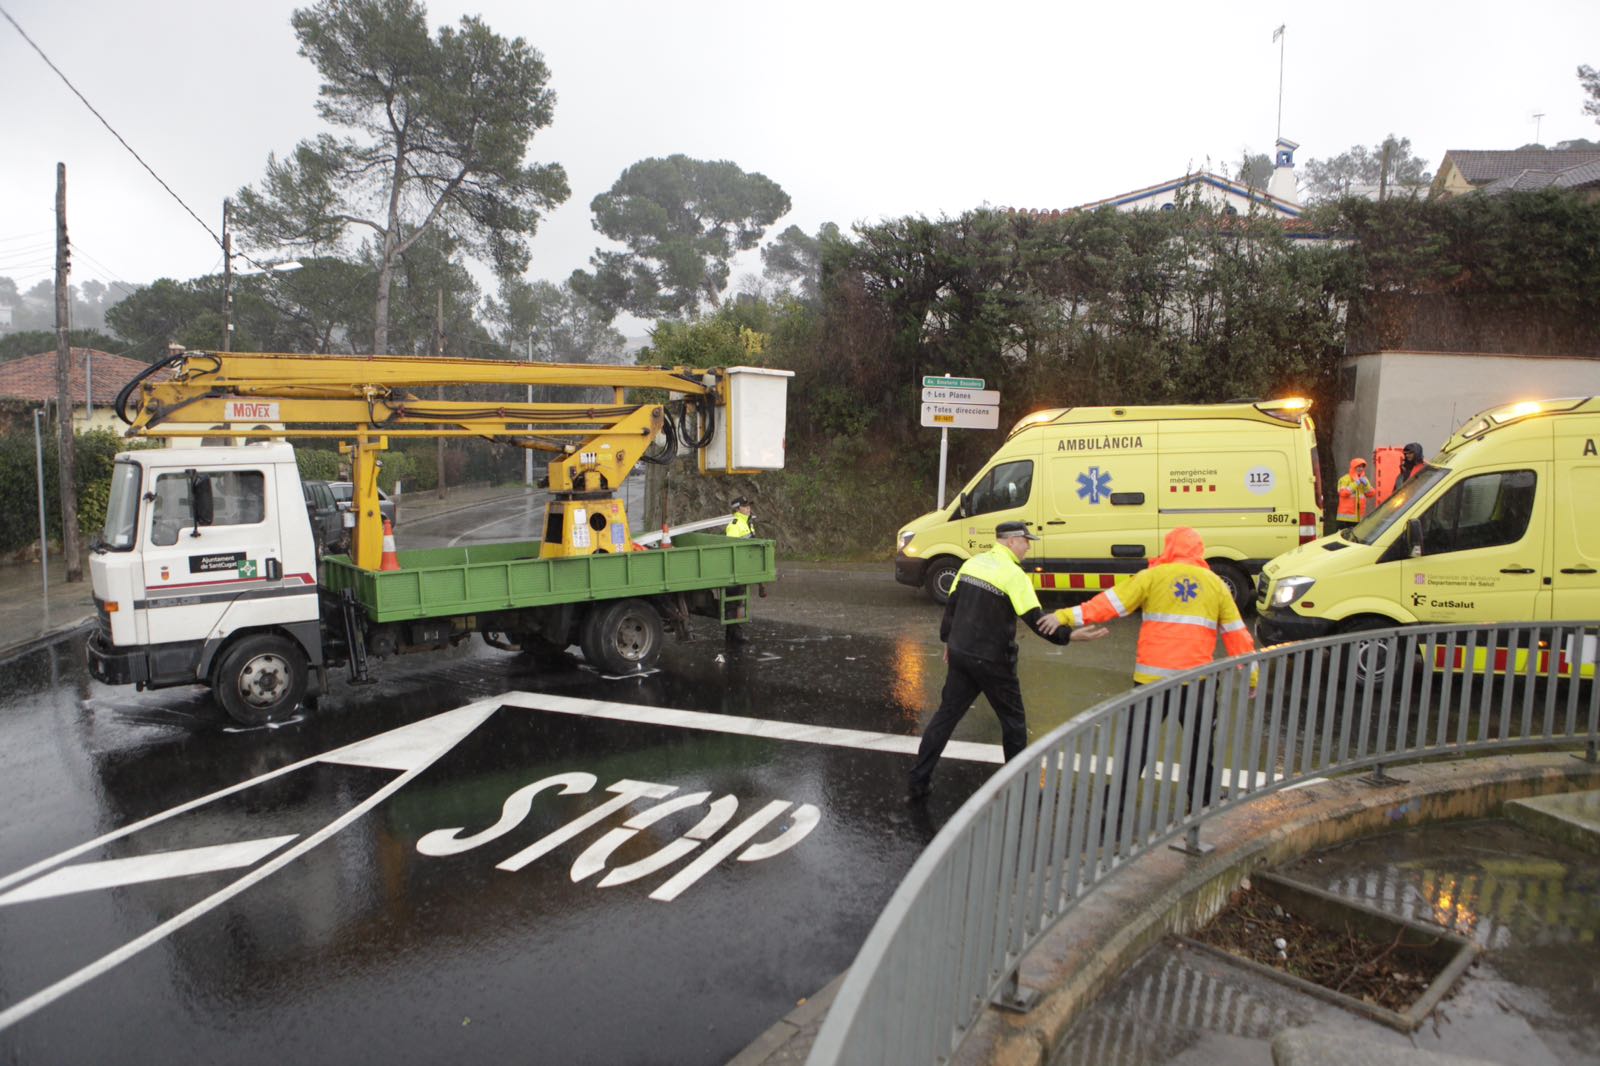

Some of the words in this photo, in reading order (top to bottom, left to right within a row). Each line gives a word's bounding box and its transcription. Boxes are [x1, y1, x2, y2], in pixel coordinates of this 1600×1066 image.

[949, 391, 971, 399] Planes
[956, 407, 990, 415] direccions
[1058, 435, 1143, 452] AMBULÀNCIA
[1169, 468, 1218, 477] emergències
[1249, 472, 1271, 483] 112
[1267, 514, 1289, 524] 8607
[201, 555, 235, 564] Ajuntament
[1430, 599, 1475, 609] CatSalut
[416, 772, 821, 902] STOP
